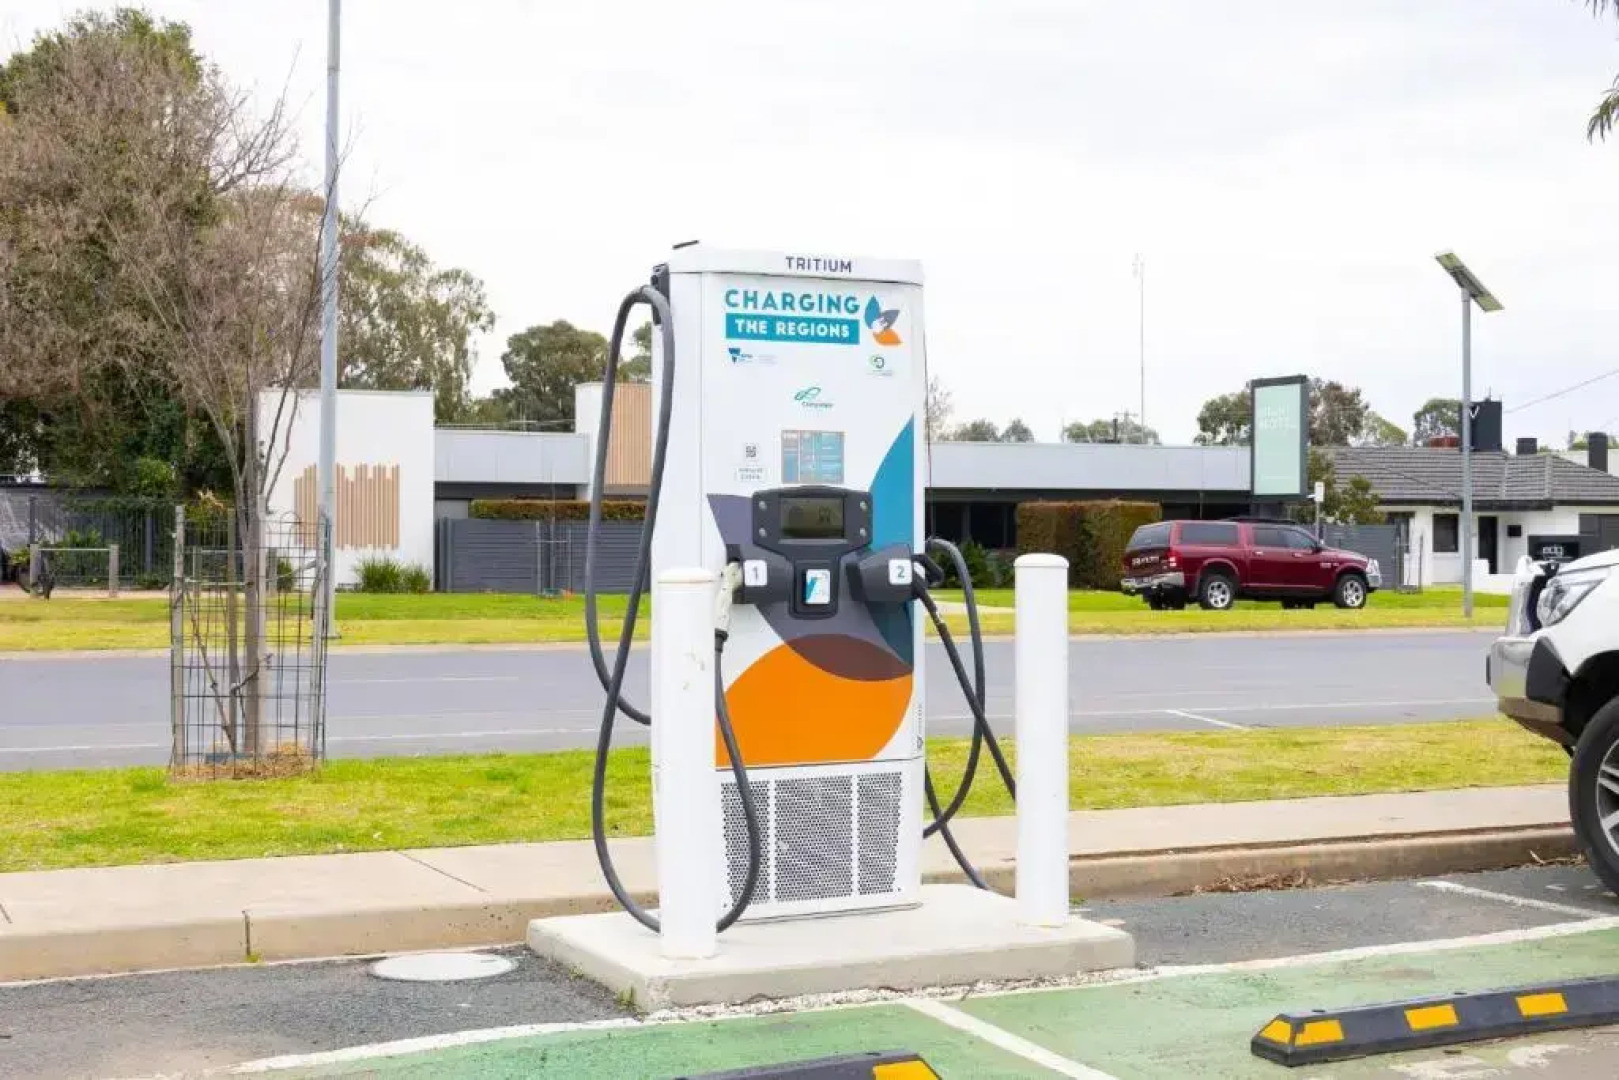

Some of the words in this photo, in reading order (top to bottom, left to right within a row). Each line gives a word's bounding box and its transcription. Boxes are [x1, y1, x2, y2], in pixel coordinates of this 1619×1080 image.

[785, 256, 852, 273] TRITIUM
[725, 289, 861, 314] CHARGING
[735, 318, 768, 335] THE
[775, 321, 850, 338] REGIONS
[753, 567, 759, 579] 1
[897, 566, 906, 578] 2
